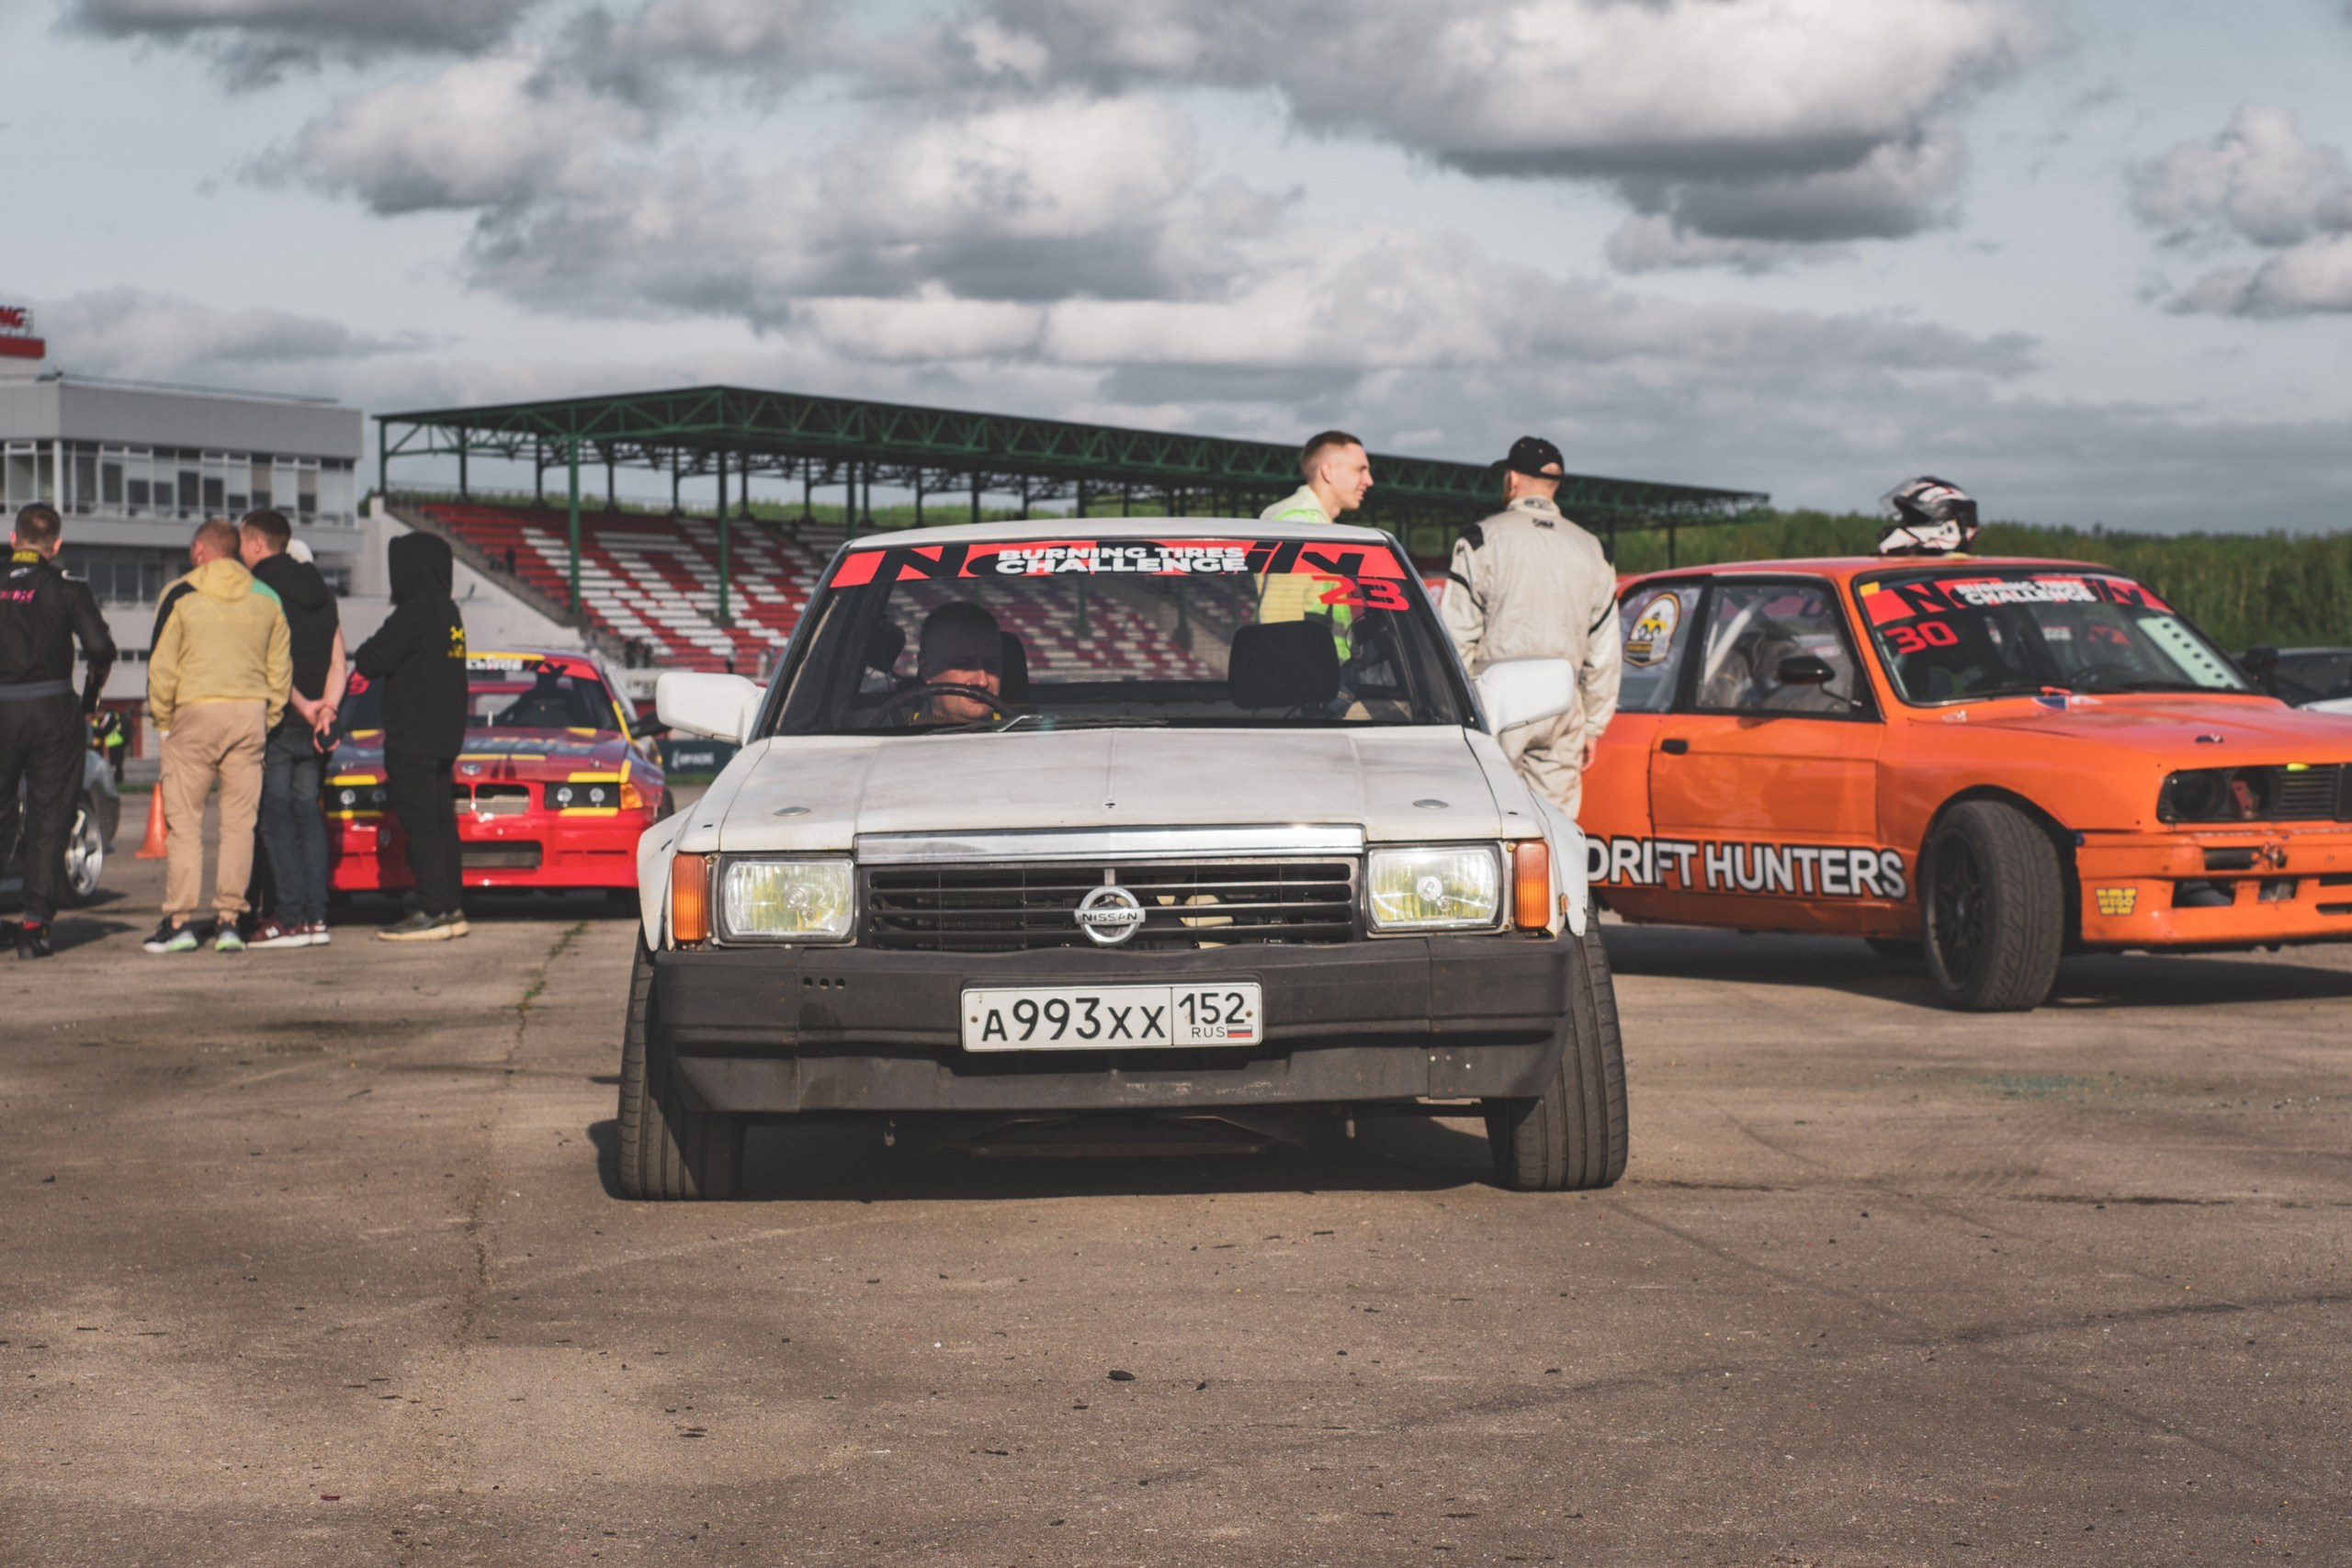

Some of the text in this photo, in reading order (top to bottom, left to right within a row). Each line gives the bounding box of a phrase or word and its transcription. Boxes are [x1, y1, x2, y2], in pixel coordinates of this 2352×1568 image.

[998, 547, 1245, 560] BURNING TIRES
[995, 558, 1249, 574] CHALLENGE
[1310, 575, 1410, 611] 23
[1964, 589, 2098, 605] CHALLENGE
[1884, 621, 1959, 654] 30
[1587, 836, 1906, 898] DRIFT HUNTERS
[1081, 912, 1138, 922] NISSAN
[1178, 992, 1246, 1025] 152
[1191, 1026, 1226, 1038] RUS
